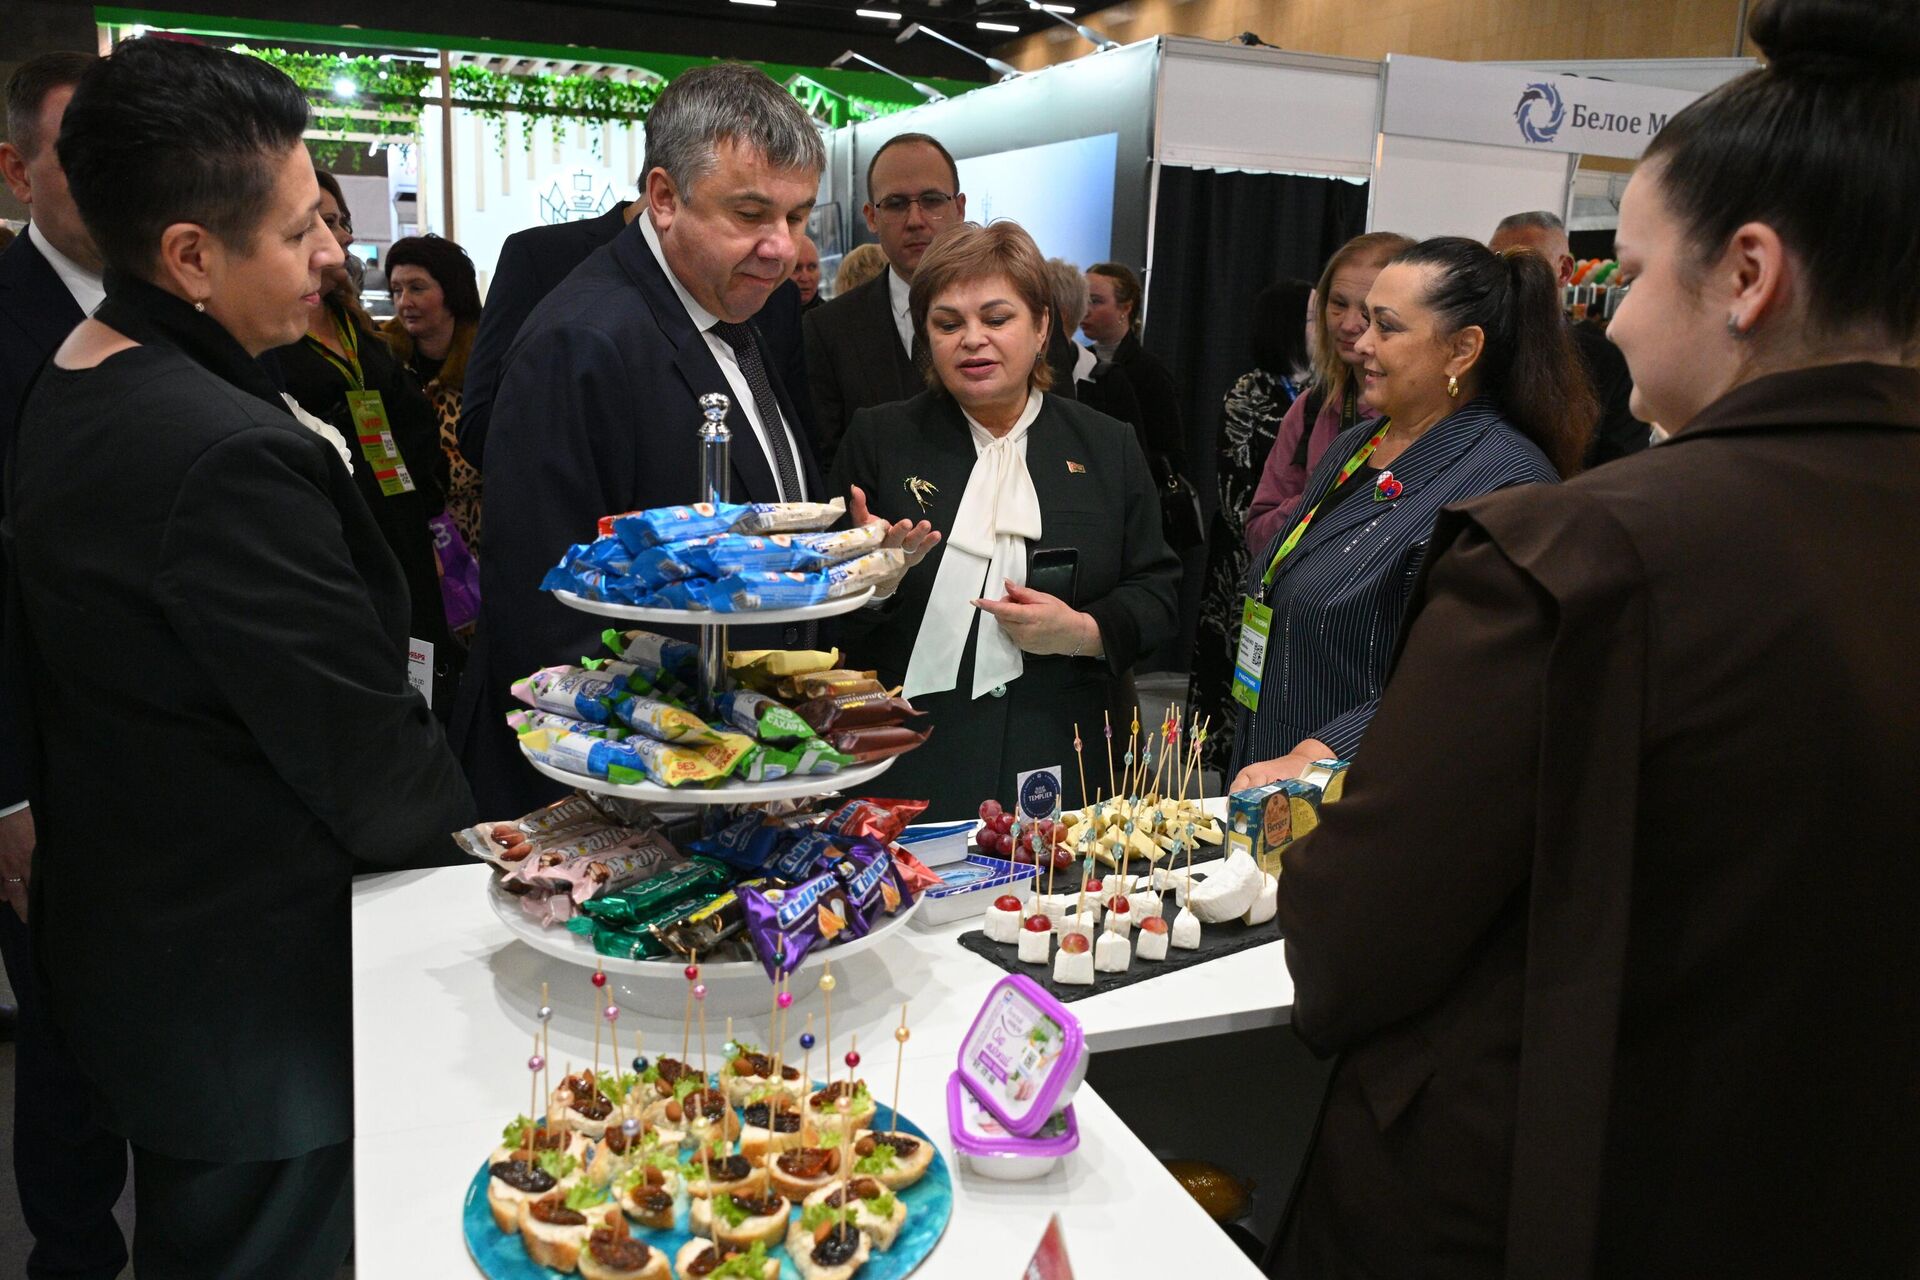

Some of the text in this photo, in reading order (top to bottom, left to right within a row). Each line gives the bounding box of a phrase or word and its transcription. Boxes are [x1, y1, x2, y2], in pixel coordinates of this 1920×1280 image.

[1571, 103, 1642, 134] Белое
[766, 711, 807, 733] САХАРА
[1028, 791, 1053, 802] TEMPLIER
